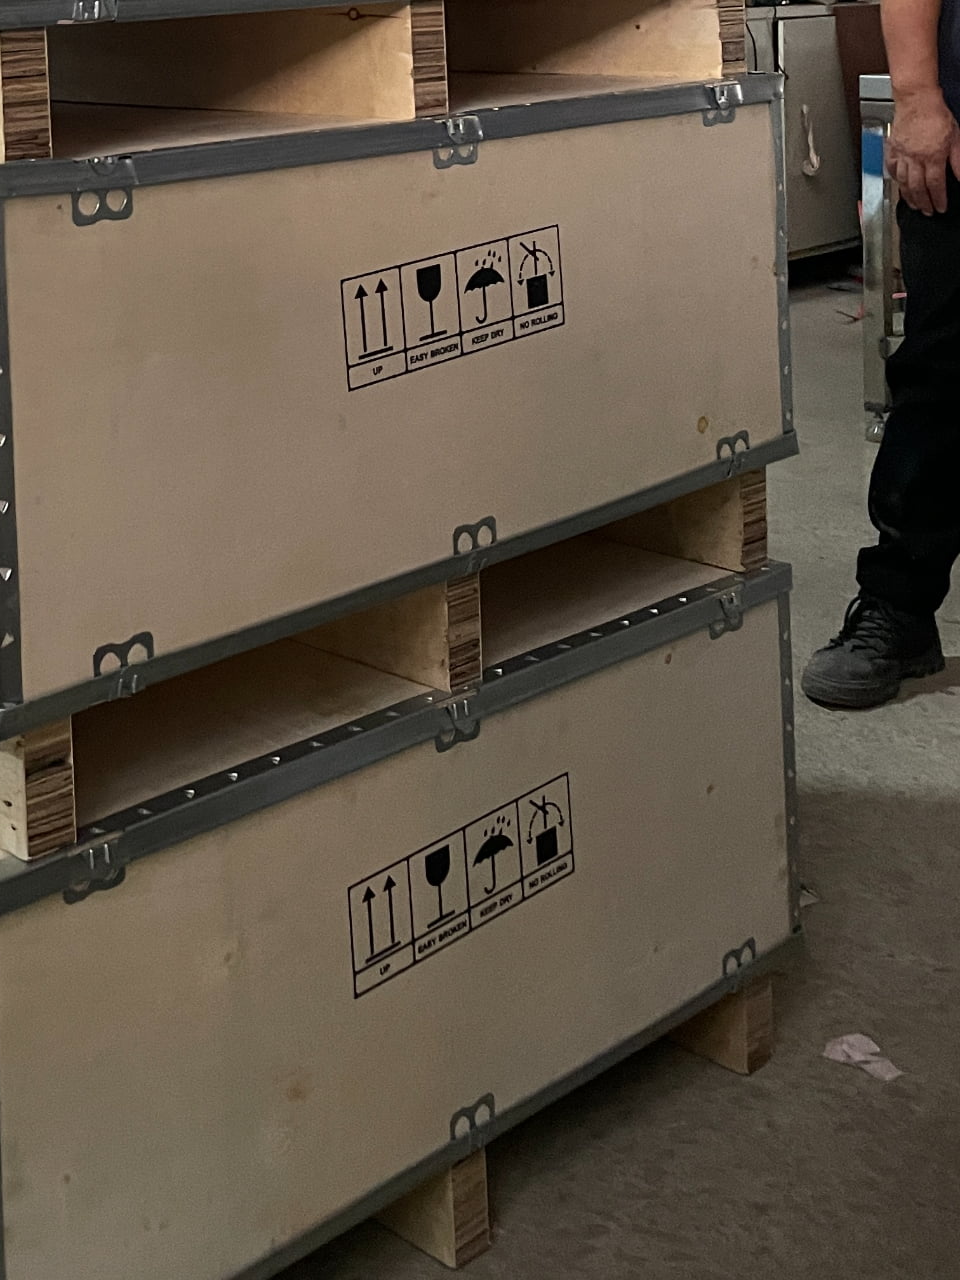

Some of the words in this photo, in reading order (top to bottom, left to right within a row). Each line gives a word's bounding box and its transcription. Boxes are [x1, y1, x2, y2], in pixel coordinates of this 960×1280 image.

[519, 320, 530, 331] NO
[530, 312, 559, 327] ROLLING
[471, 334, 489, 345] KEEP
[490, 328, 505, 340] DRY
[410, 352, 429, 364] EASY
[430, 342, 460, 359] BROKEN
[372, 365, 384, 376] UP
[527, 877, 540, 890] NO
[540, 862, 568, 884] ROLLING
[479, 902, 498, 919] KEEP
[499, 893, 514, 908] DRY
[417, 936, 437, 954] EASY
[438, 919, 468, 942] BROKEN
[379, 963, 391, 976] UP
